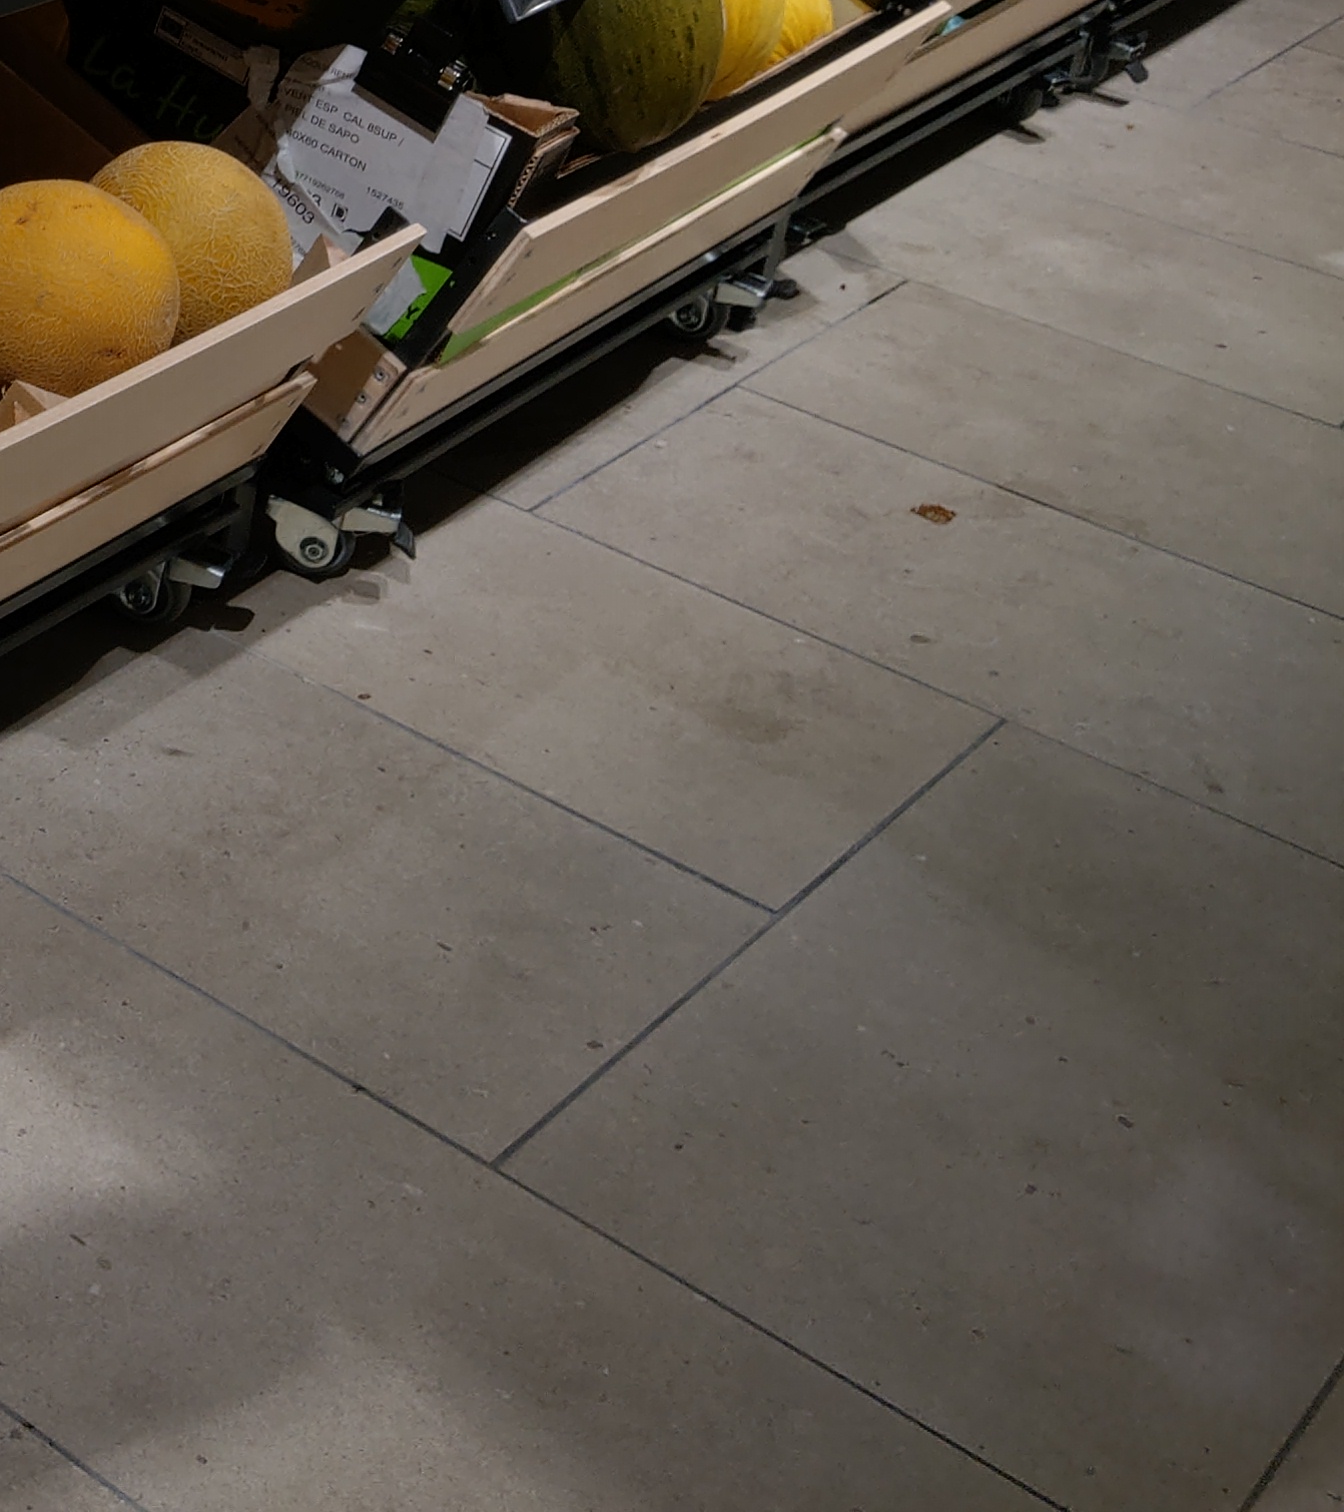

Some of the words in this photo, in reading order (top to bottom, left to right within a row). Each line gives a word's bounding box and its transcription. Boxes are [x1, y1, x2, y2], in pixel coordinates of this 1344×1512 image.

[315, 99, 338, 114] ESP
[343, 112, 364, 129] CAL
[310, 116, 326, 129] DE
[328, 121, 360, 144] SAPO
[320, 144, 367, 172] CARTON
